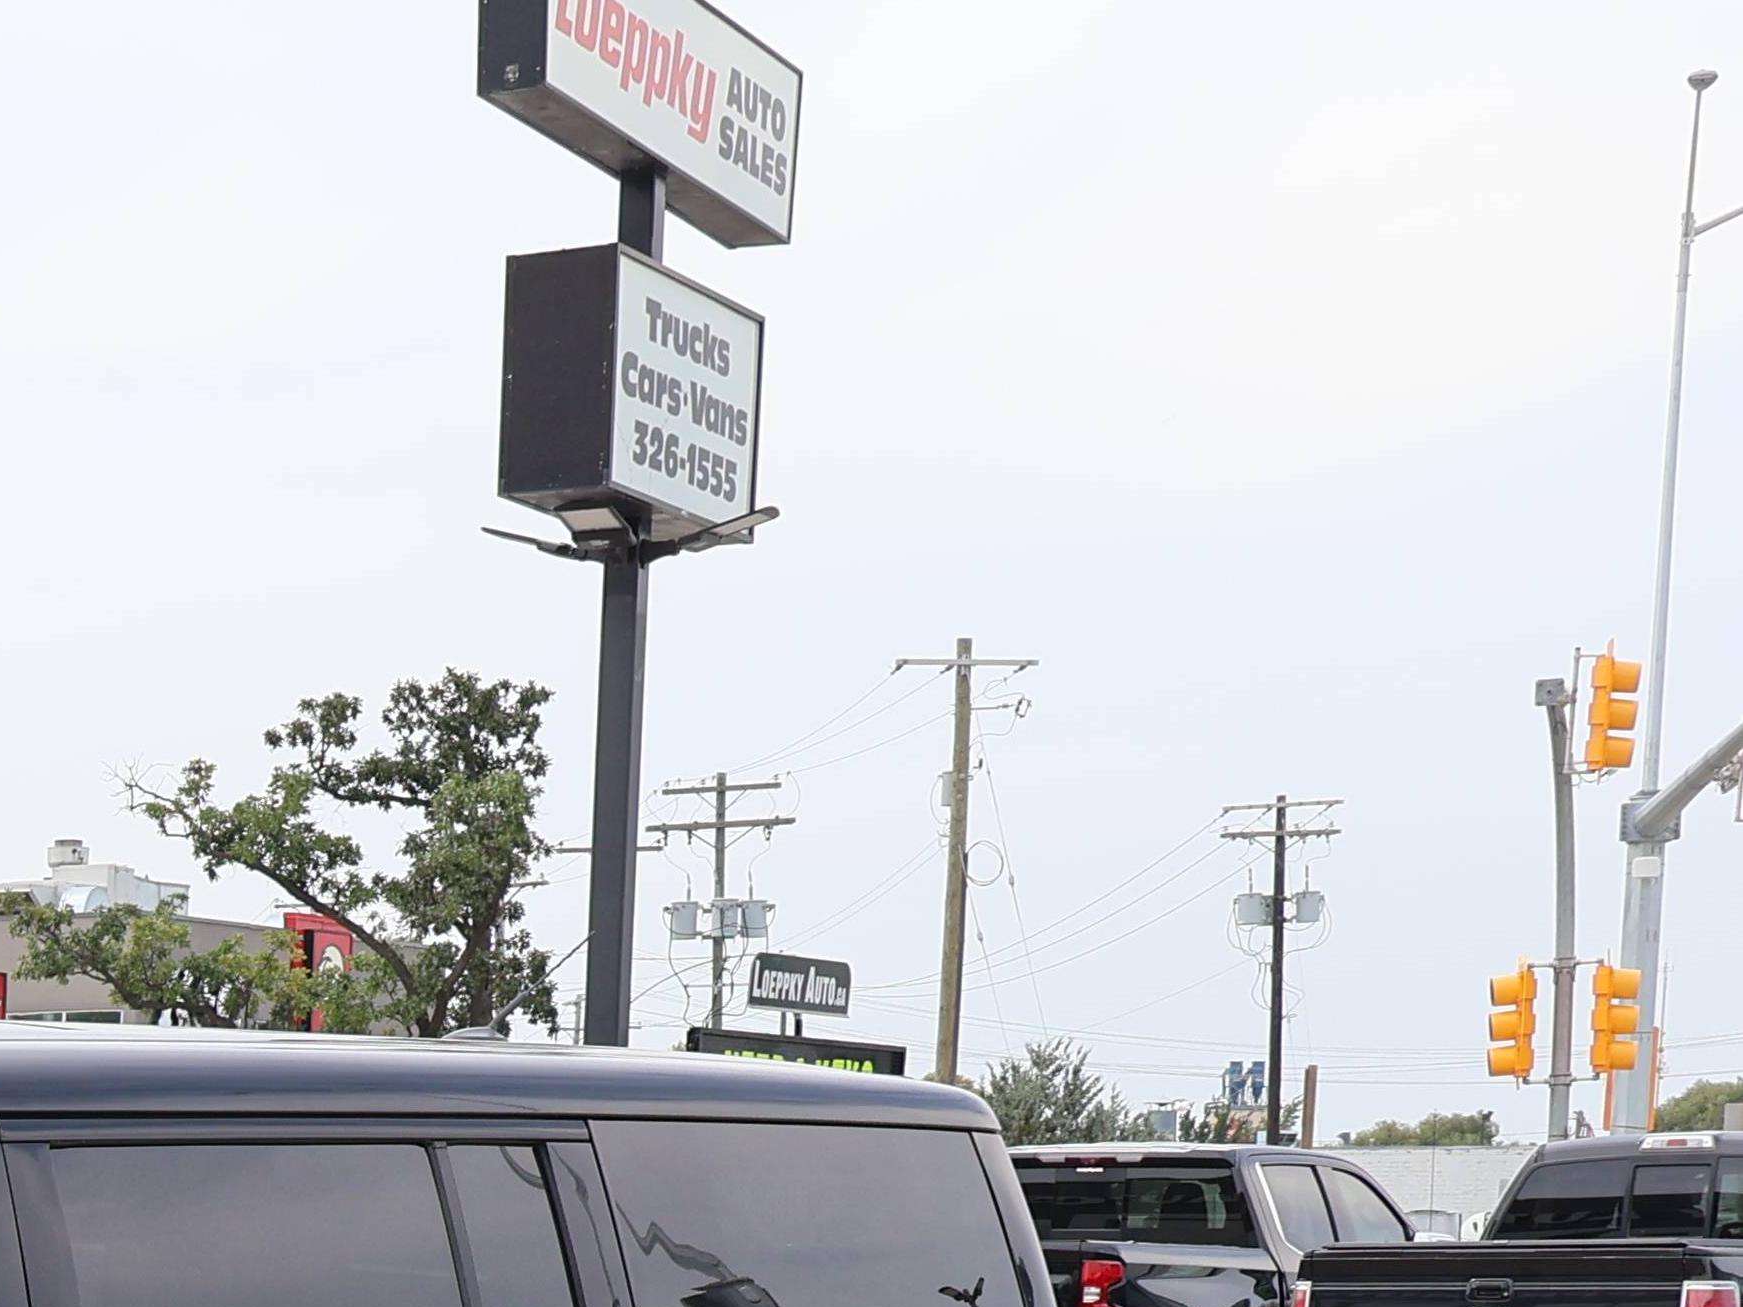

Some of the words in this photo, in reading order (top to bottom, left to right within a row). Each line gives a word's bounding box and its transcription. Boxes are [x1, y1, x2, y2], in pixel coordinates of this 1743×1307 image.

[726, 66, 786, 142] AUTO
[718, 115, 788, 196] SALES
[645, 296, 730, 377] Trucks
[632, 419, 738, 503] 326-1555
